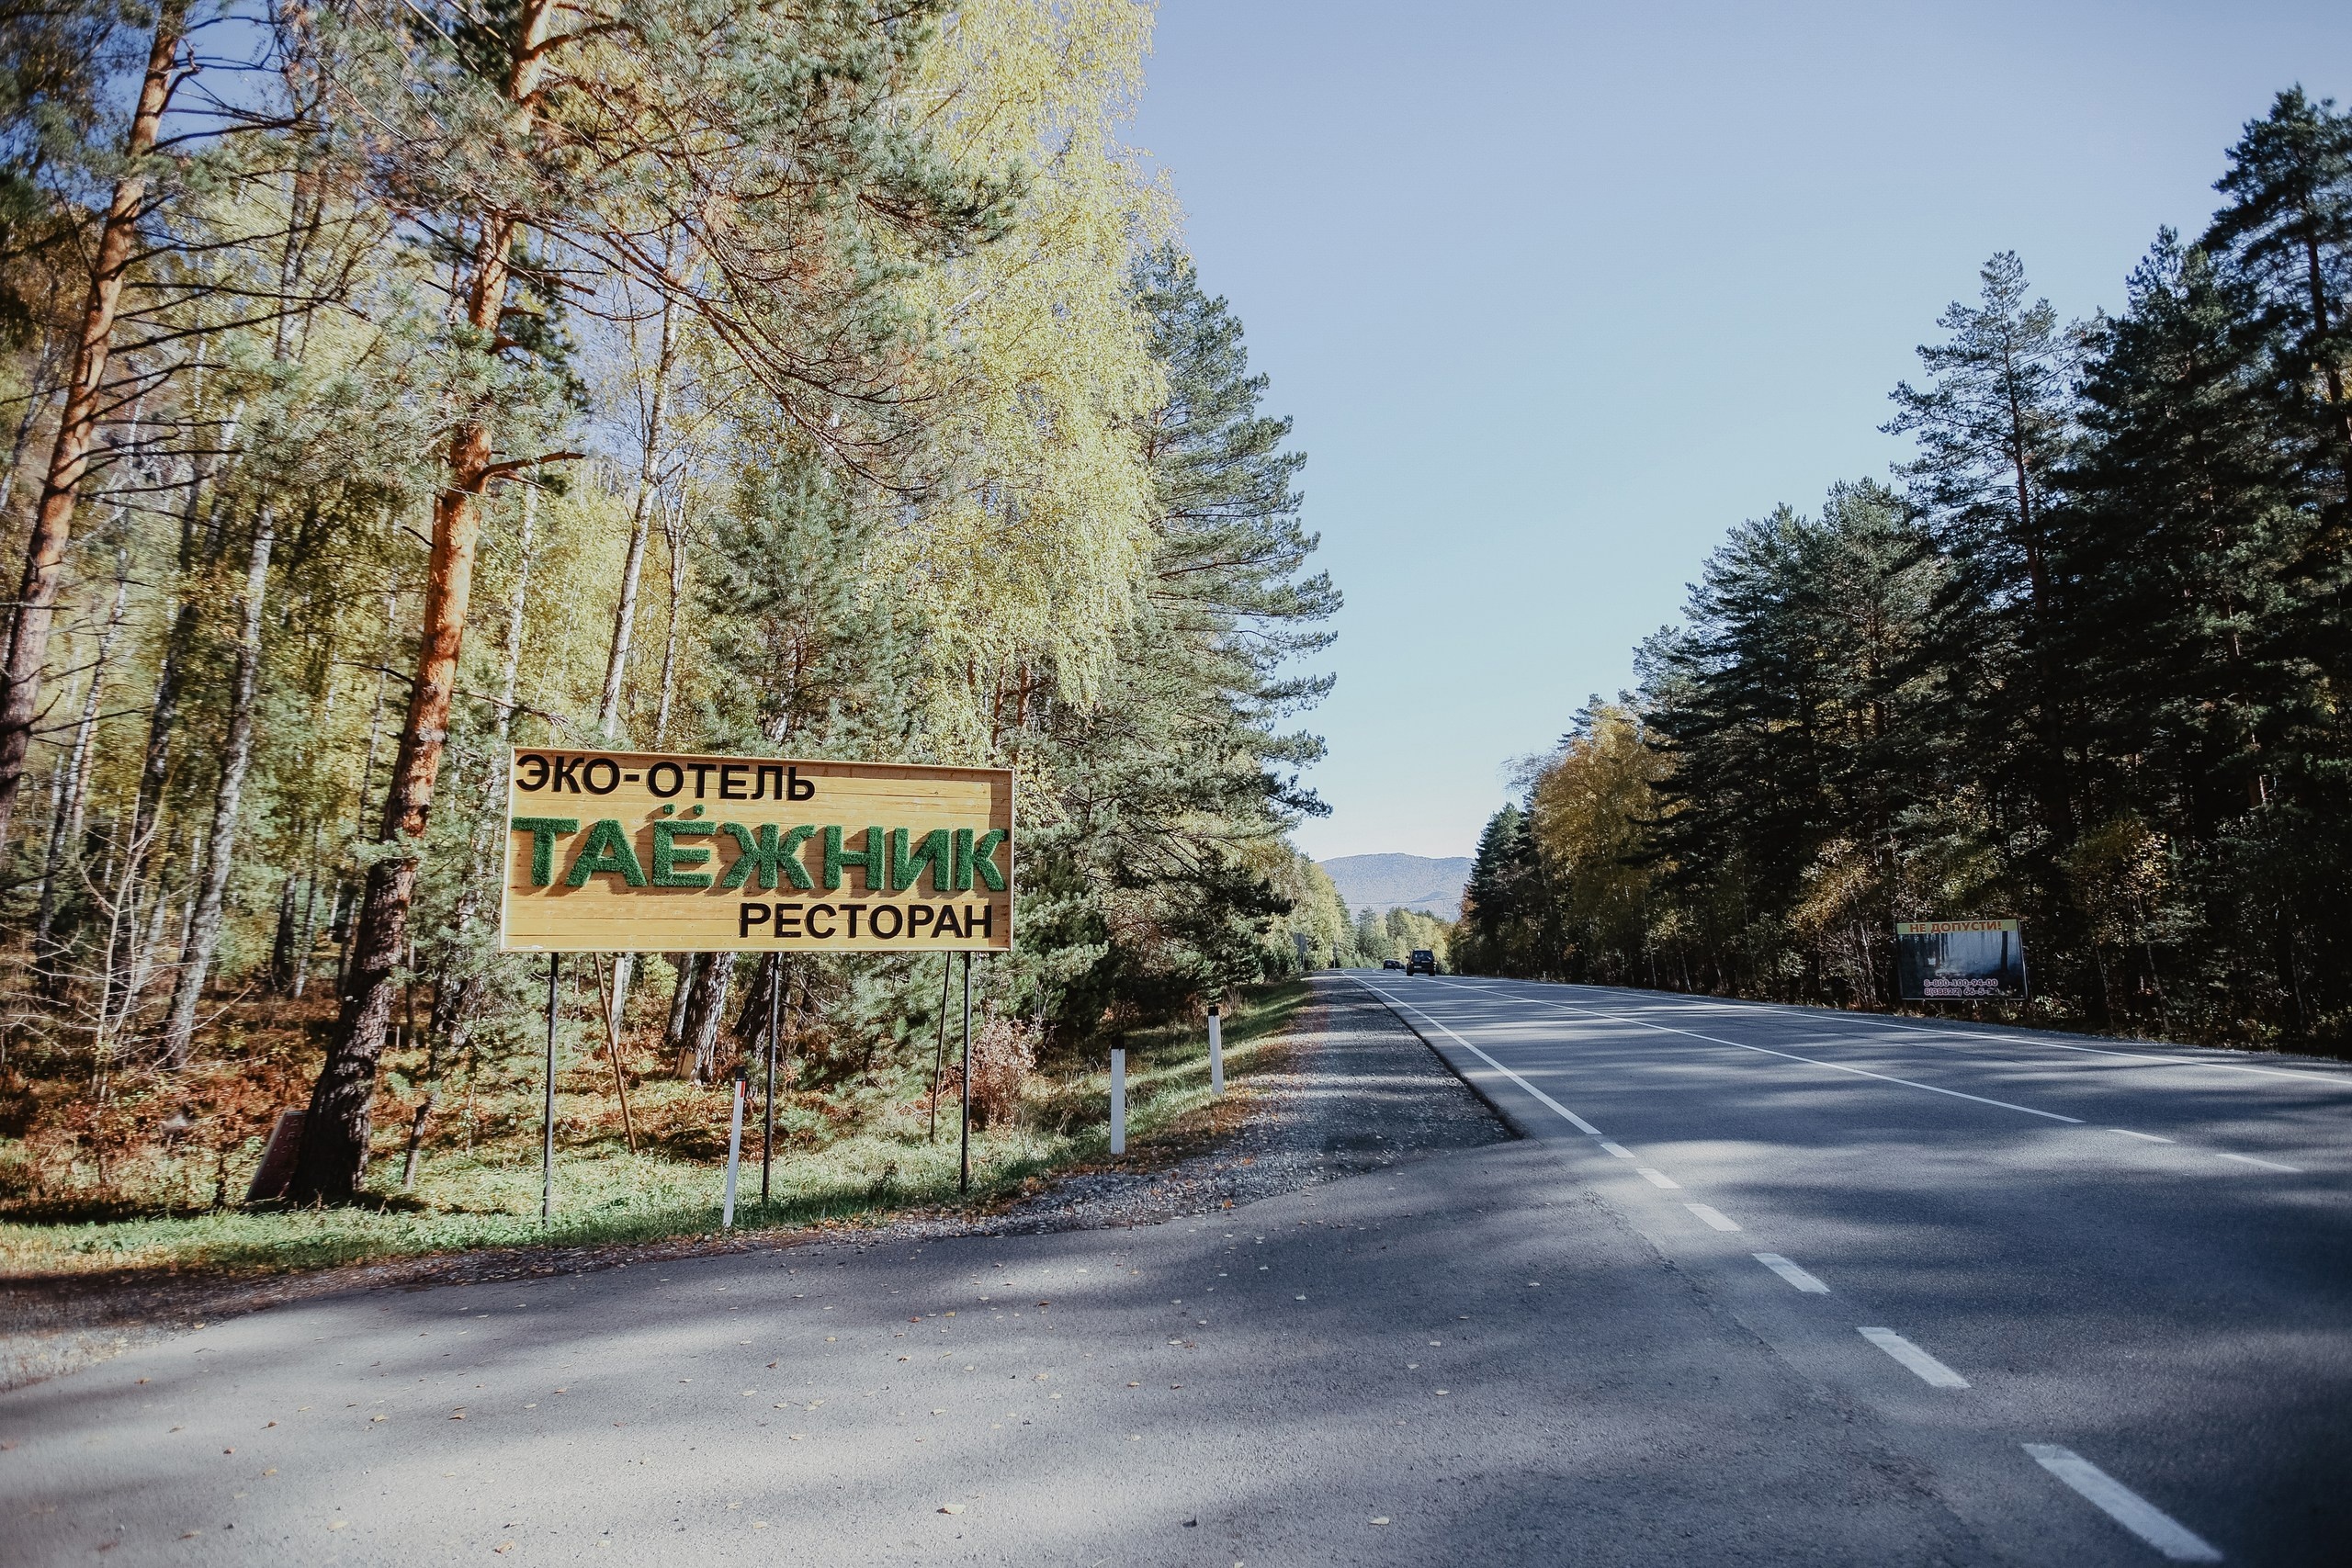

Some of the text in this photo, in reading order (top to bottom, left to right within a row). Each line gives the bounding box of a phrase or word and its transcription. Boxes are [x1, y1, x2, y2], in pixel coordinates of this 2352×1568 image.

[515, 754, 816, 802] ЭКО-ОТЕЛЬ
[512, 804, 1009, 892] ТАЁЖНИК
[740, 903, 993, 939] РЕСТОРАН
[1910, 921, 2002, 933] НЕ ДОПУСТИ!
[1924, 978, 1998, 987] 8-800-100-94-00
[1924, 987, 1962, 997] 8(38822)
